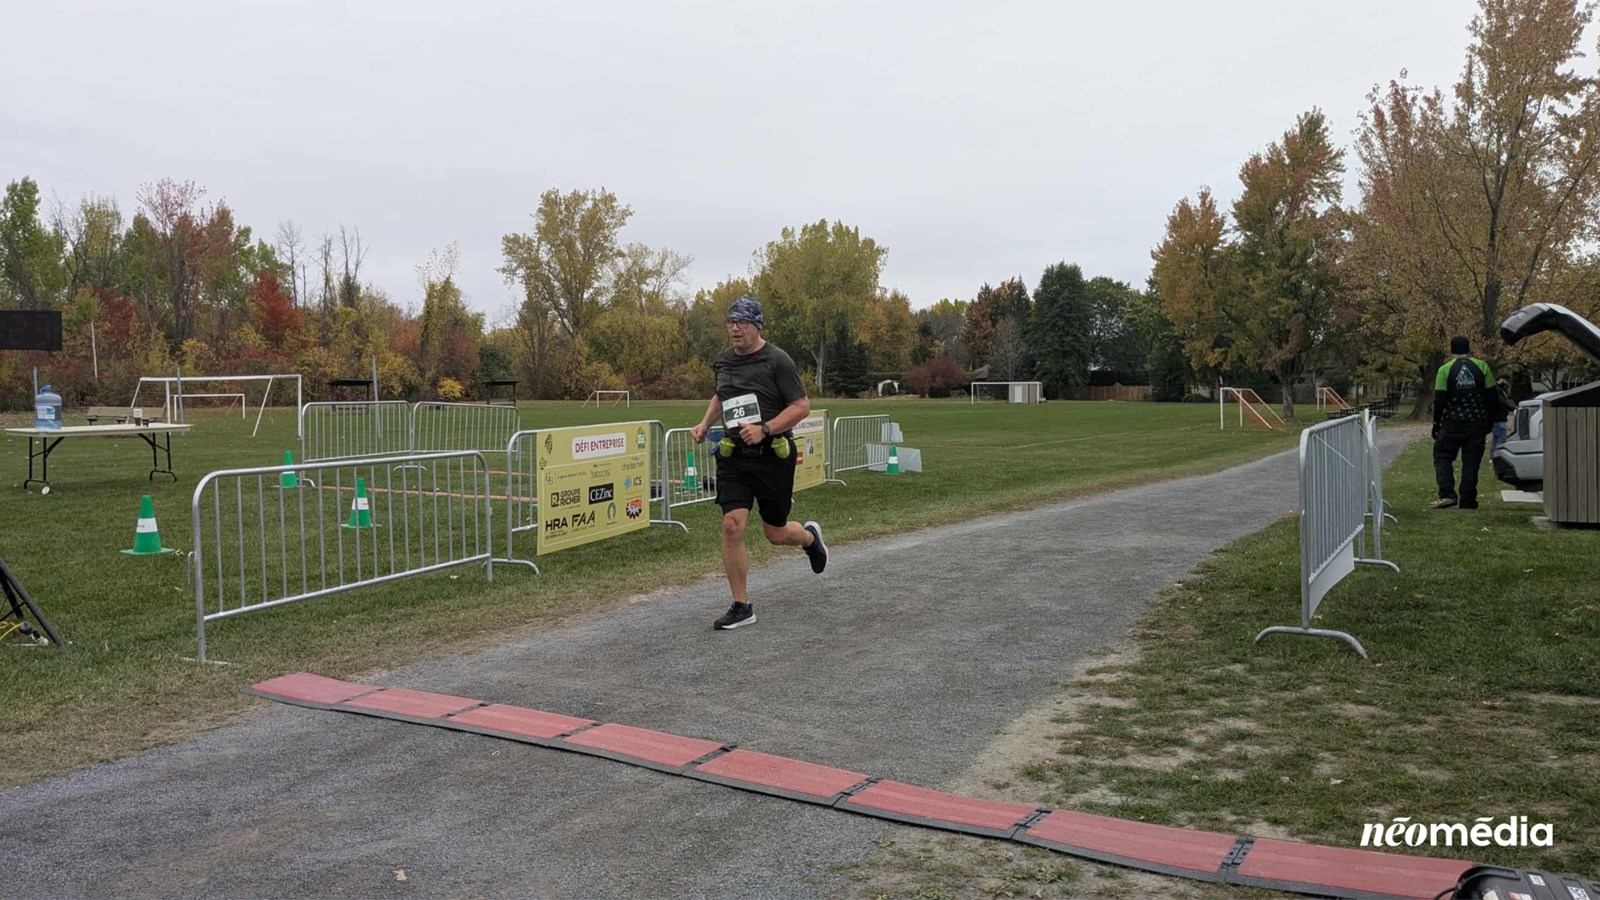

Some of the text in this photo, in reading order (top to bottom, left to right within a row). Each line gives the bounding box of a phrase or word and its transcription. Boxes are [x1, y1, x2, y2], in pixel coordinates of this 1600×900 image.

[732, 406, 746, 419] 26
[575, 438, 624, 453] DÉFI ENTREPRISE
[560, 488, 581, 498] GROUPE
[560, 496, 581, 506] RICHER
[545, 510, 595, 532] HRA FAA
